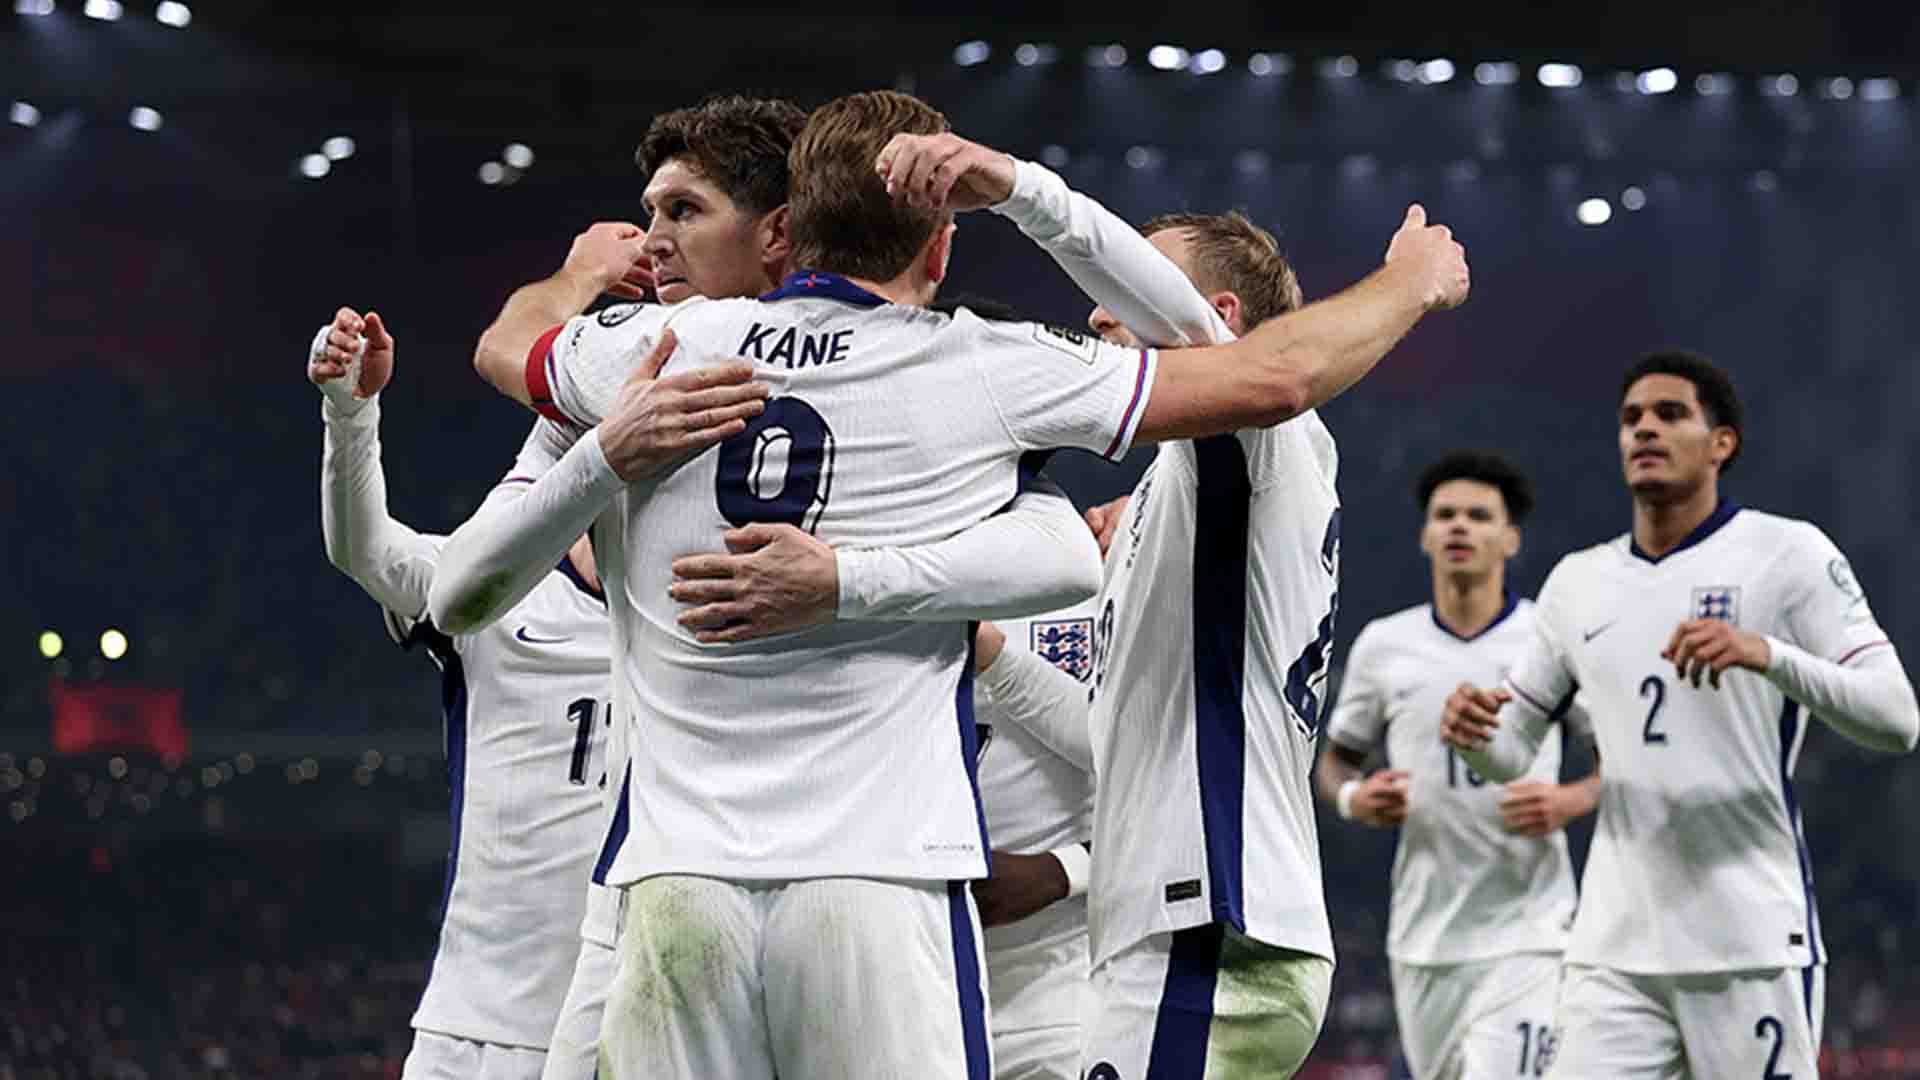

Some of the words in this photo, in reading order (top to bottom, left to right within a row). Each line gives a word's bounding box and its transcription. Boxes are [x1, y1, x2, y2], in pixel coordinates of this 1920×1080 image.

[738, 322, 854, 369] KANE
[566, 698, 612, 789] 1
[1640, 675, 1668, 745] 2
[1755, 1016, 1792, 1080] 2
